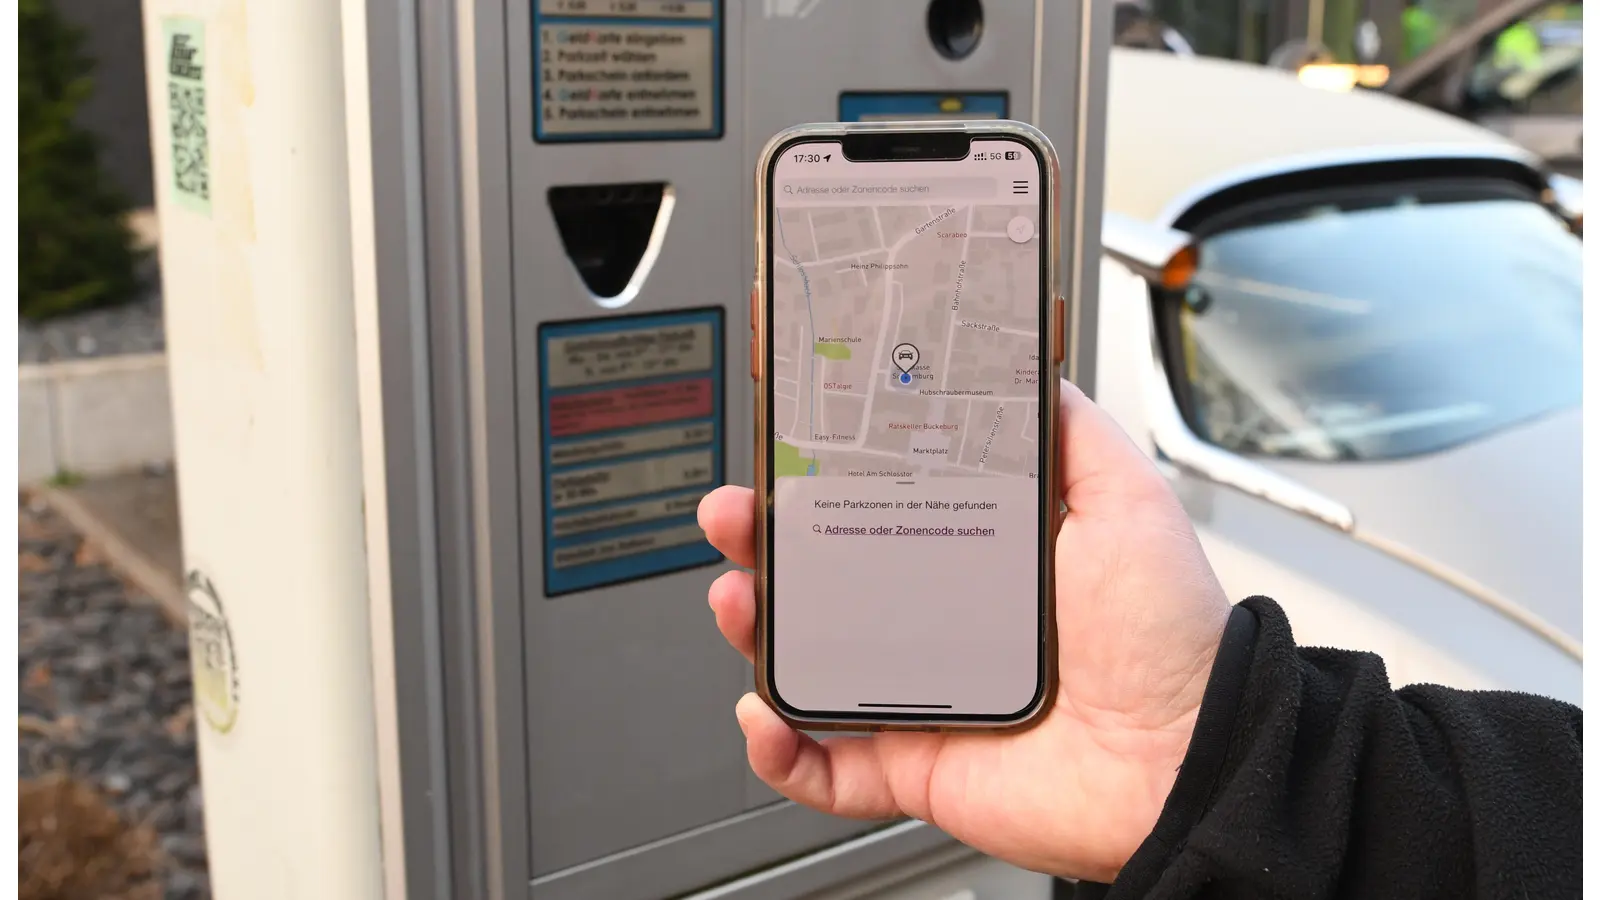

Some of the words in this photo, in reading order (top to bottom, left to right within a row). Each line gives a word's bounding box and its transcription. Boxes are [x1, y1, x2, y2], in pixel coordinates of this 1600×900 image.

[793, 153, 821, 163] 17:30
[990, 152, 1002, 160] 5G
[796, 185, 830, 194] Adresse
[831, 184, 850, 194] oder
[852, 184, 898, 194] Zonencode
[900, 184, 930, 193] suchen
[914, 206, 956, 236] Gartenstraße
[936, 231, 968, 239] Scarabeo
[870, 262, 909, 271] Philippsohn
[951, 260, 967, 311] Bahnhofstraße
[960, 319, 1001, 333] Sackstraße
[818, 336, 862, 344] Marienschule
[919, 389, 994, 397] Hubschraubermuseum
[814, 433, 856, 442] Easy-Fitness
[979, 406, 1005, 464] Petersilienstraße
[912, 447, 949, 456] Marktplatz
[878, 470, 913, 478] Schlosstor
[814, 500, 841, 509] Keine
[843, 500, 893, 509] Parkzonen
[895, 500, 904, 509] in
[906, 500, 922, 510] der
[925, 500, 950, 510] Nähe
[953, 500, 998, 512] gefunden
[825, 525, 867, 535] Adresse
[869, 525, 893, 536] oder
[896, 525, 955, 537] Zonencode
[957, 526, 995, 537] suchen
